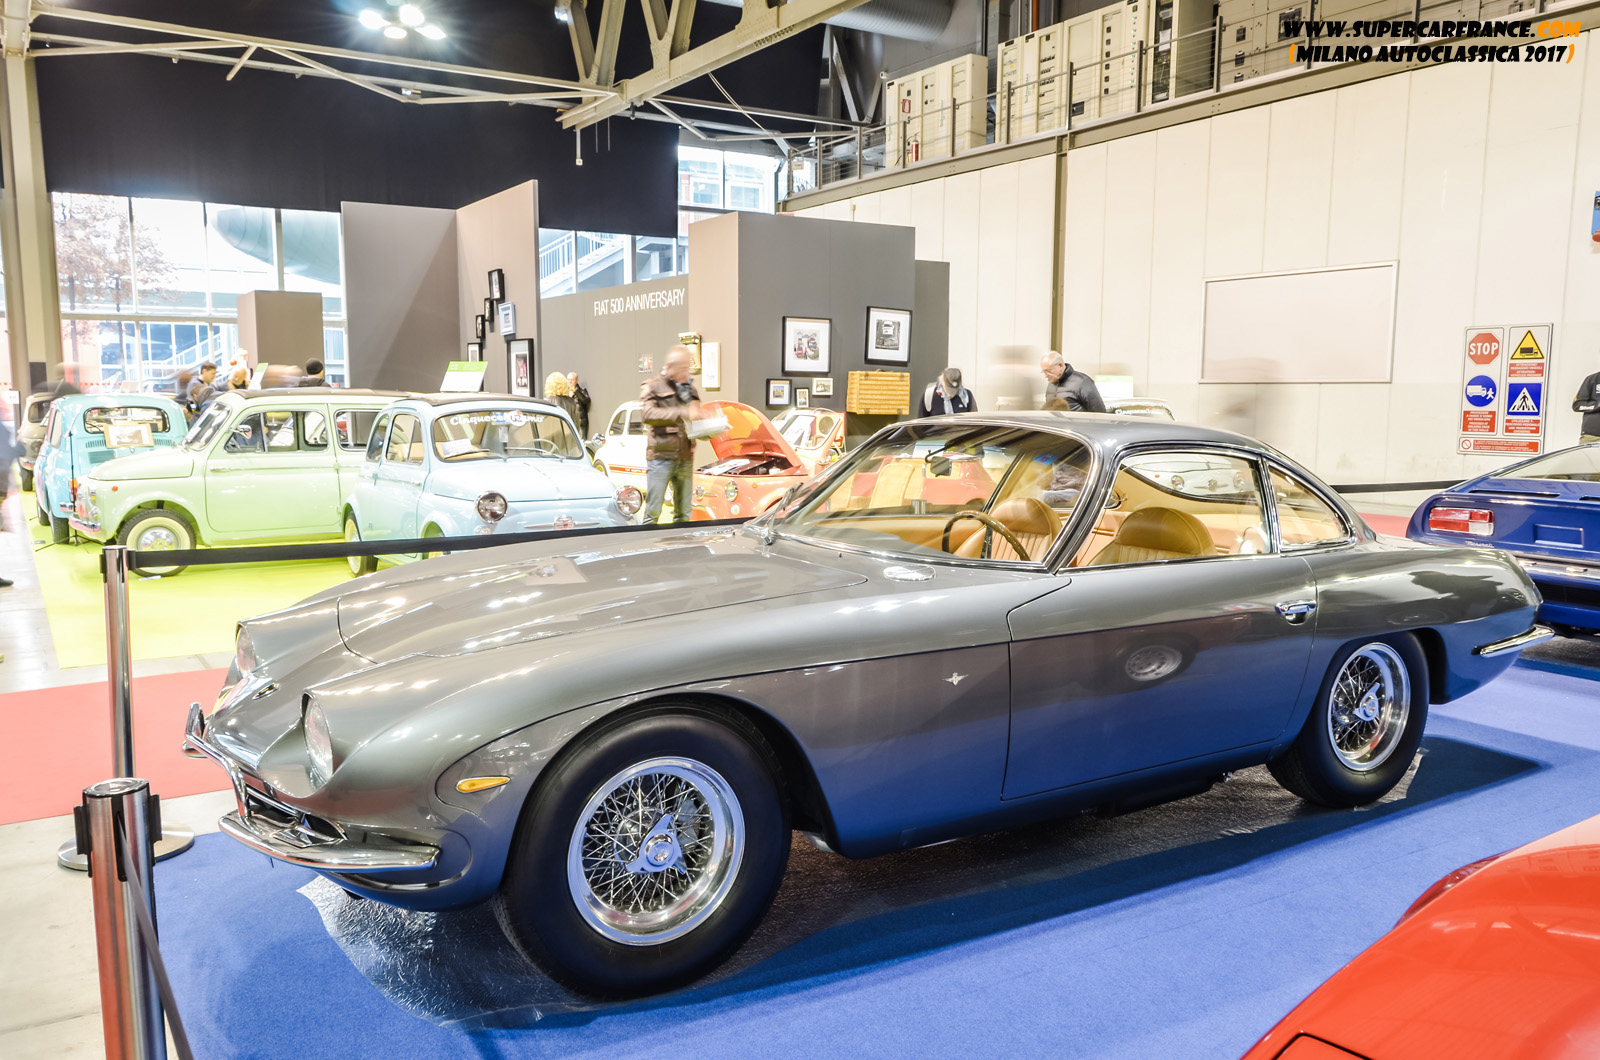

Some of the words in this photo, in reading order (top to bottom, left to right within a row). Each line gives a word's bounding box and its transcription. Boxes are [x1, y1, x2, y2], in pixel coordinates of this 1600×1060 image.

[594, 299, 609, 316] FIAT
[610, 297, 624, 314] 500
[625, 287, 685, 312] ANNIVERSARY
[1469, 342, 1499, 355] STOP
